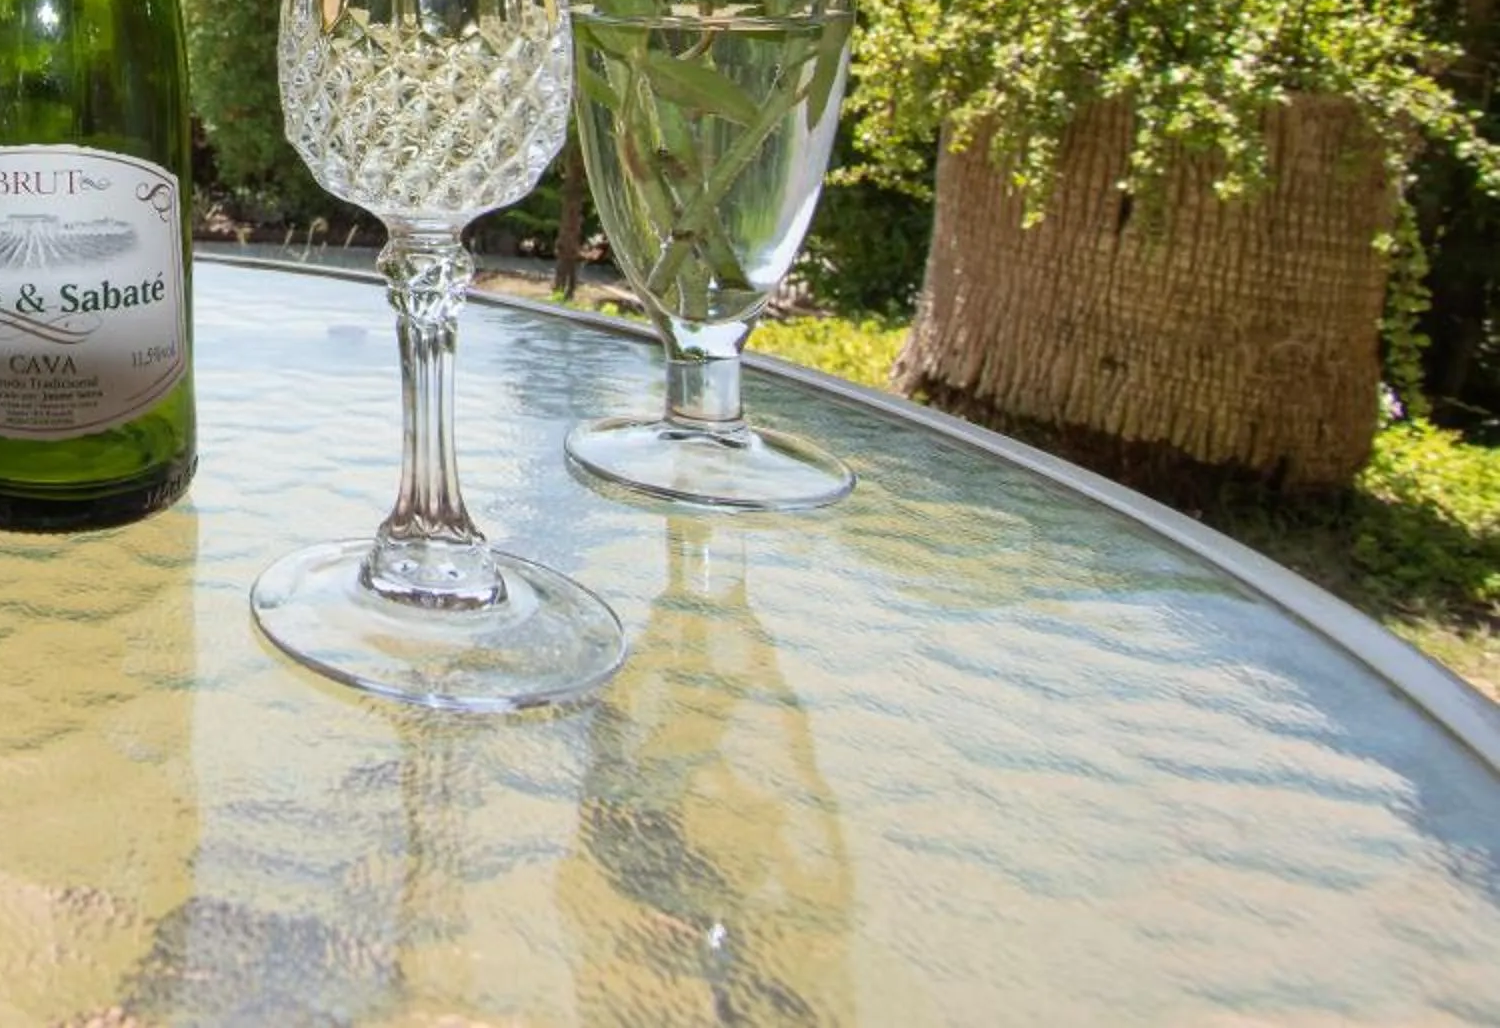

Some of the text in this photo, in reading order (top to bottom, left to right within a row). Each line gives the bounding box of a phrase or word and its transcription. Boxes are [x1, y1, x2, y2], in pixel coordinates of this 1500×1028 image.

[15, 283, 46, 314] &
[60, 271, 166, 314] Sabaté
[9, 354, 77, 374] CAVA
